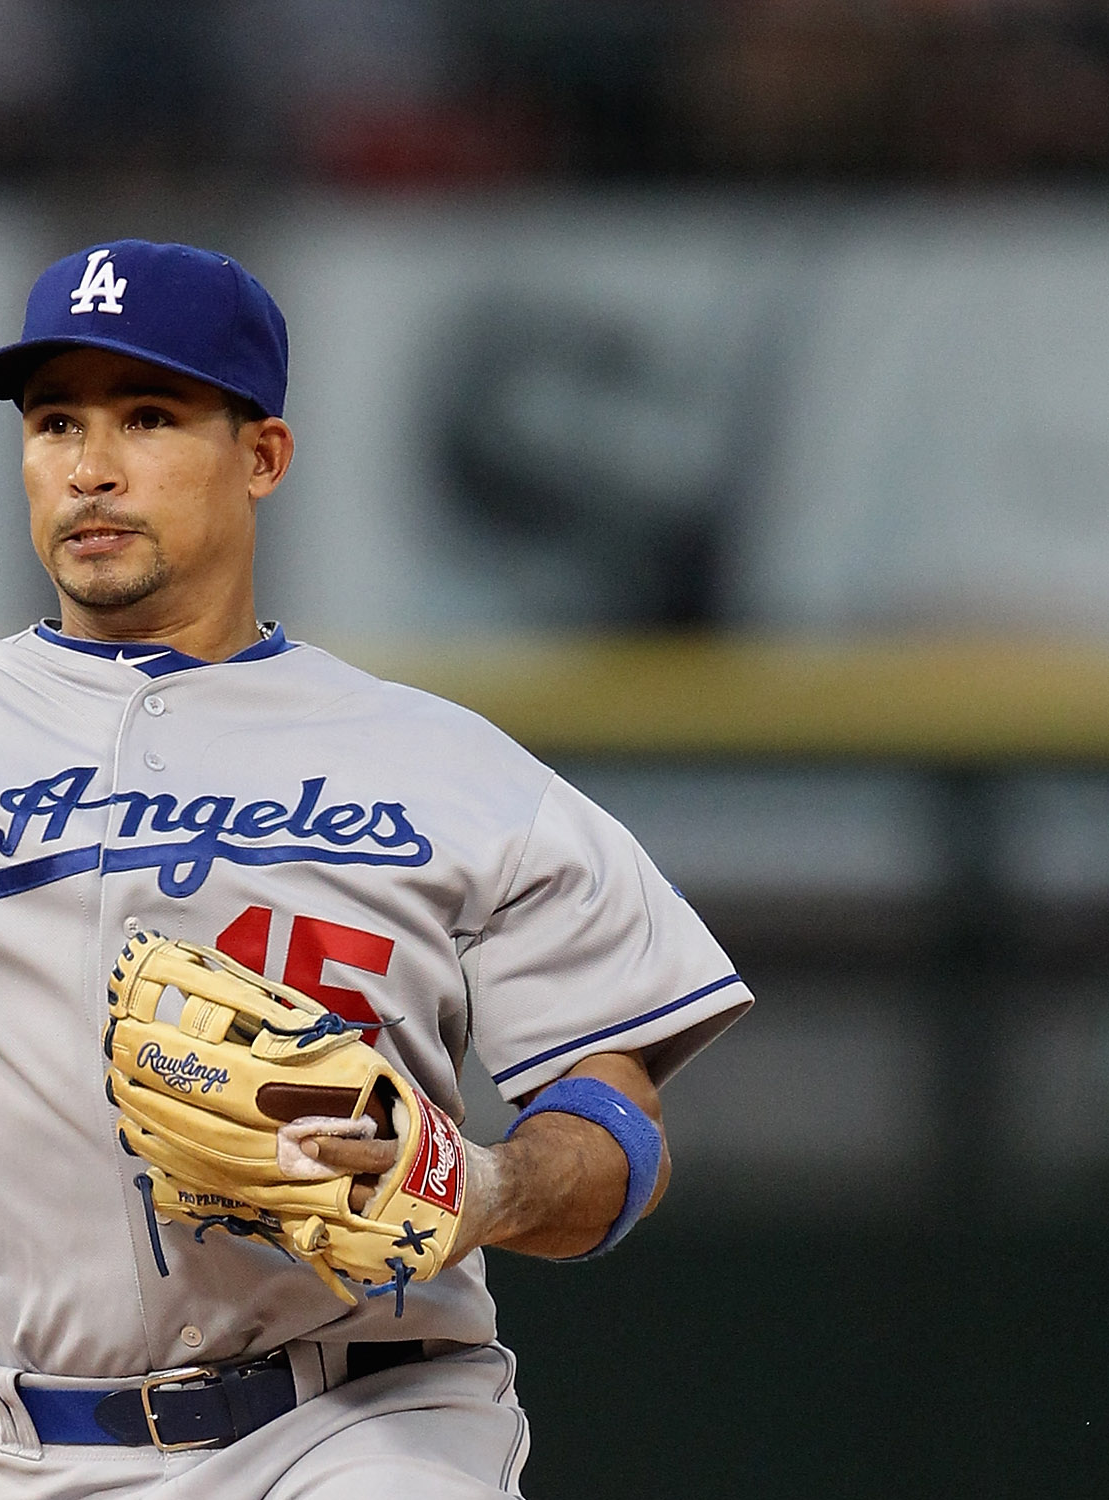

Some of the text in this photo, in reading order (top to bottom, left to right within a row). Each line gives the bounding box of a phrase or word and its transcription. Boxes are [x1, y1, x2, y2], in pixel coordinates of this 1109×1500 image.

[70, 249, 127, 315] LA
[216, 905, 395, 1047] 15
[137, 1041, 231, 1094] Rawlings
